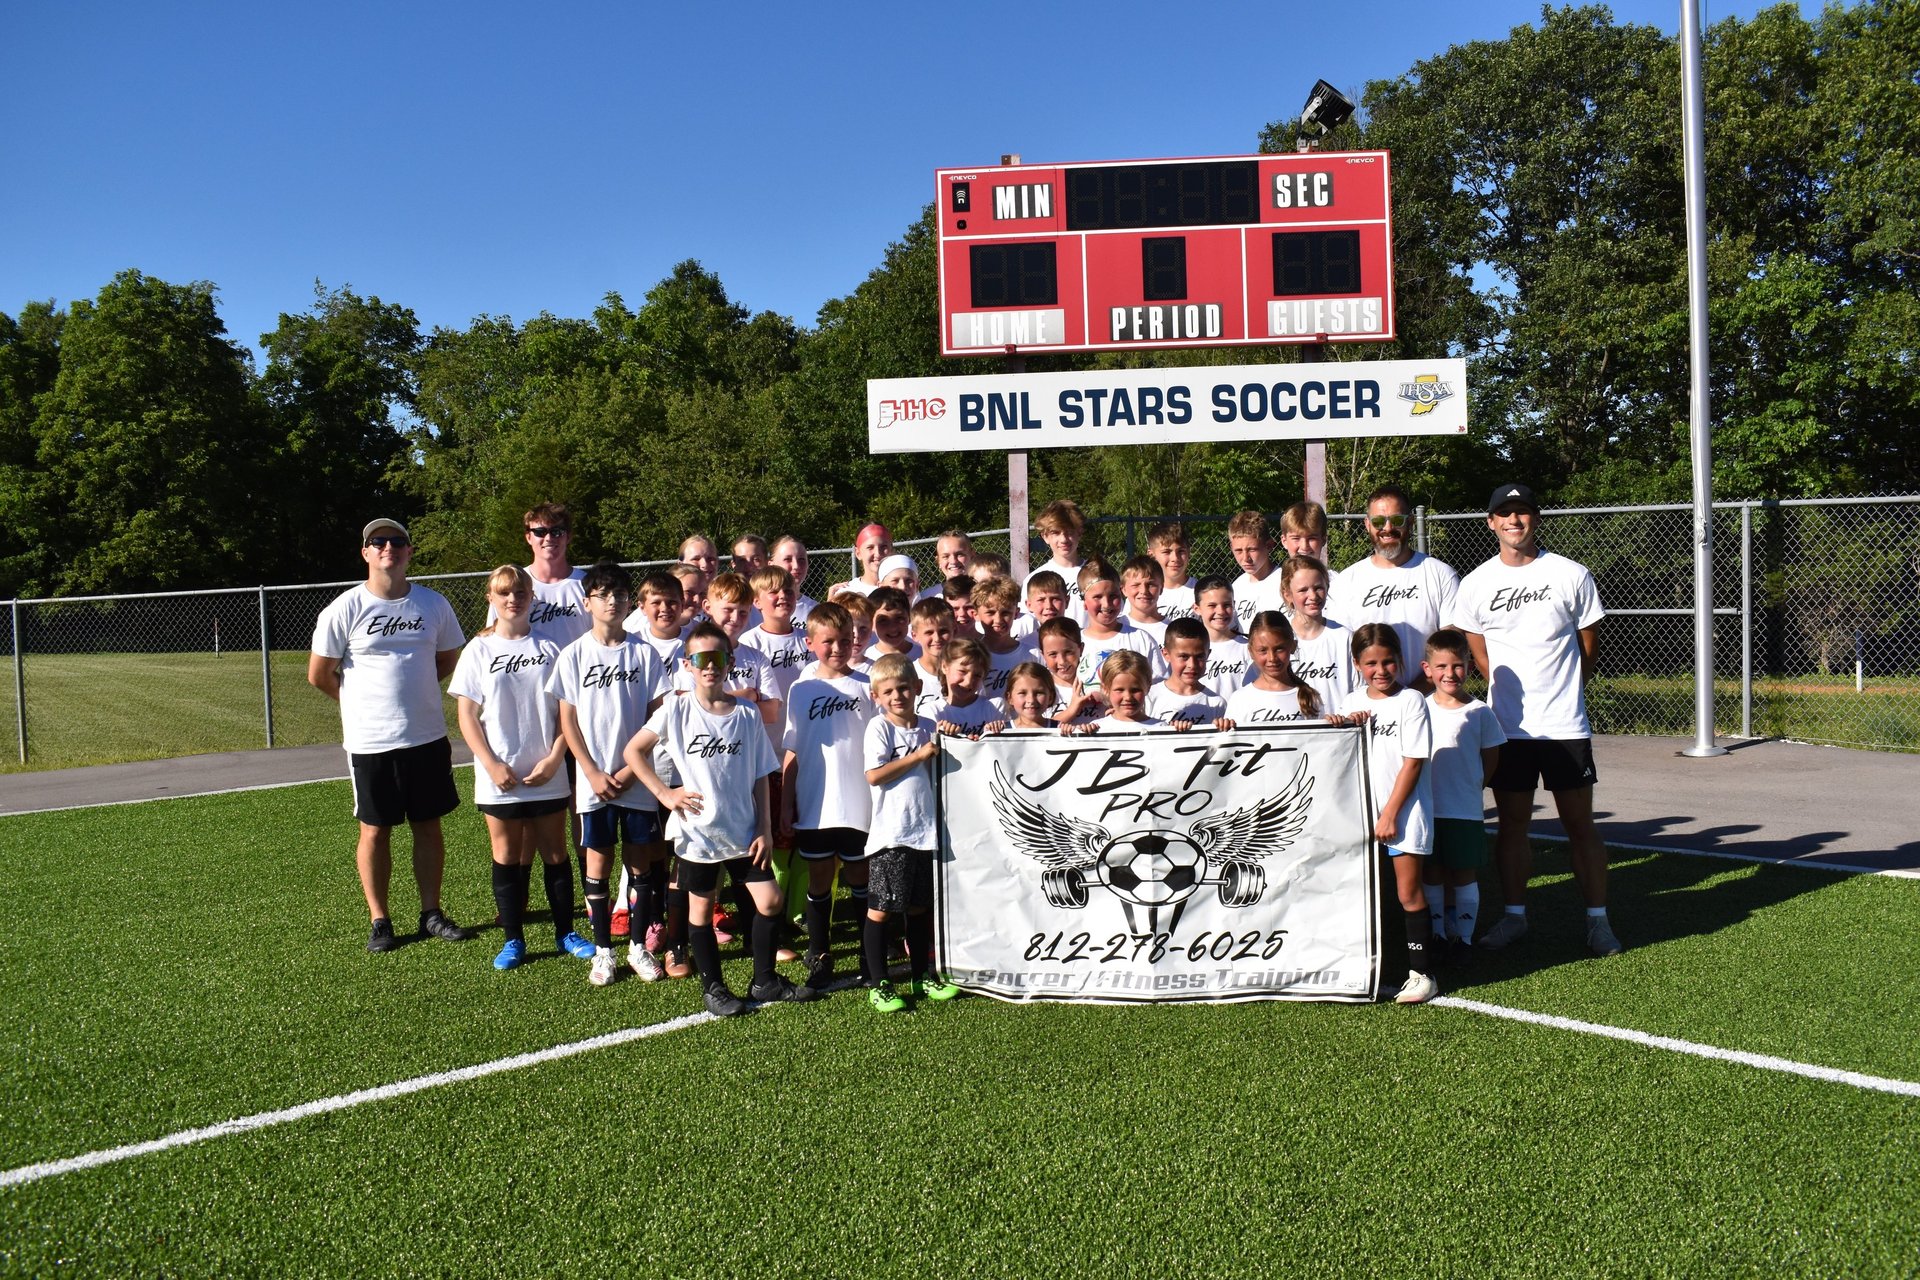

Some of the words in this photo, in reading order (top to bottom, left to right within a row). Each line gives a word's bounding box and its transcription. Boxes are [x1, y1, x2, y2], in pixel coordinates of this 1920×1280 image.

[995, 183, 1050, 219] MIN
[1276, 172, 1329, 208] SEC
[970, 311, 1046, 347] HOME
[1112, 303, 1220, 341] PERIOD
[1273, 299, 1377, 335] GUESTS
[959, 391, 1042, 432] BNL
[1058, 385, 1193, 429] STARS
[1211, 379, 1381, 424] SOCCER
[1399, 382, 1454, 403] IHSAA
[1361, 584, 1419, 608] Effort.
[1489, 584, 1552, 612] Effort.
[366, 615, 425, 637] Effort.
[489, 653, 549, 674] Effort.
[583, 664, 640, 689] Effort.
[809, 696, 861, 720] Effort.
[686, 733, 742, 758] Effort.
[1173, 742, 1298, 791] Fit
[1099, 790, 1213, 823] PRO
[1023, 930, 1289, 964] 812-278-6025
[1096, 970, 1207, 990] Fitness
